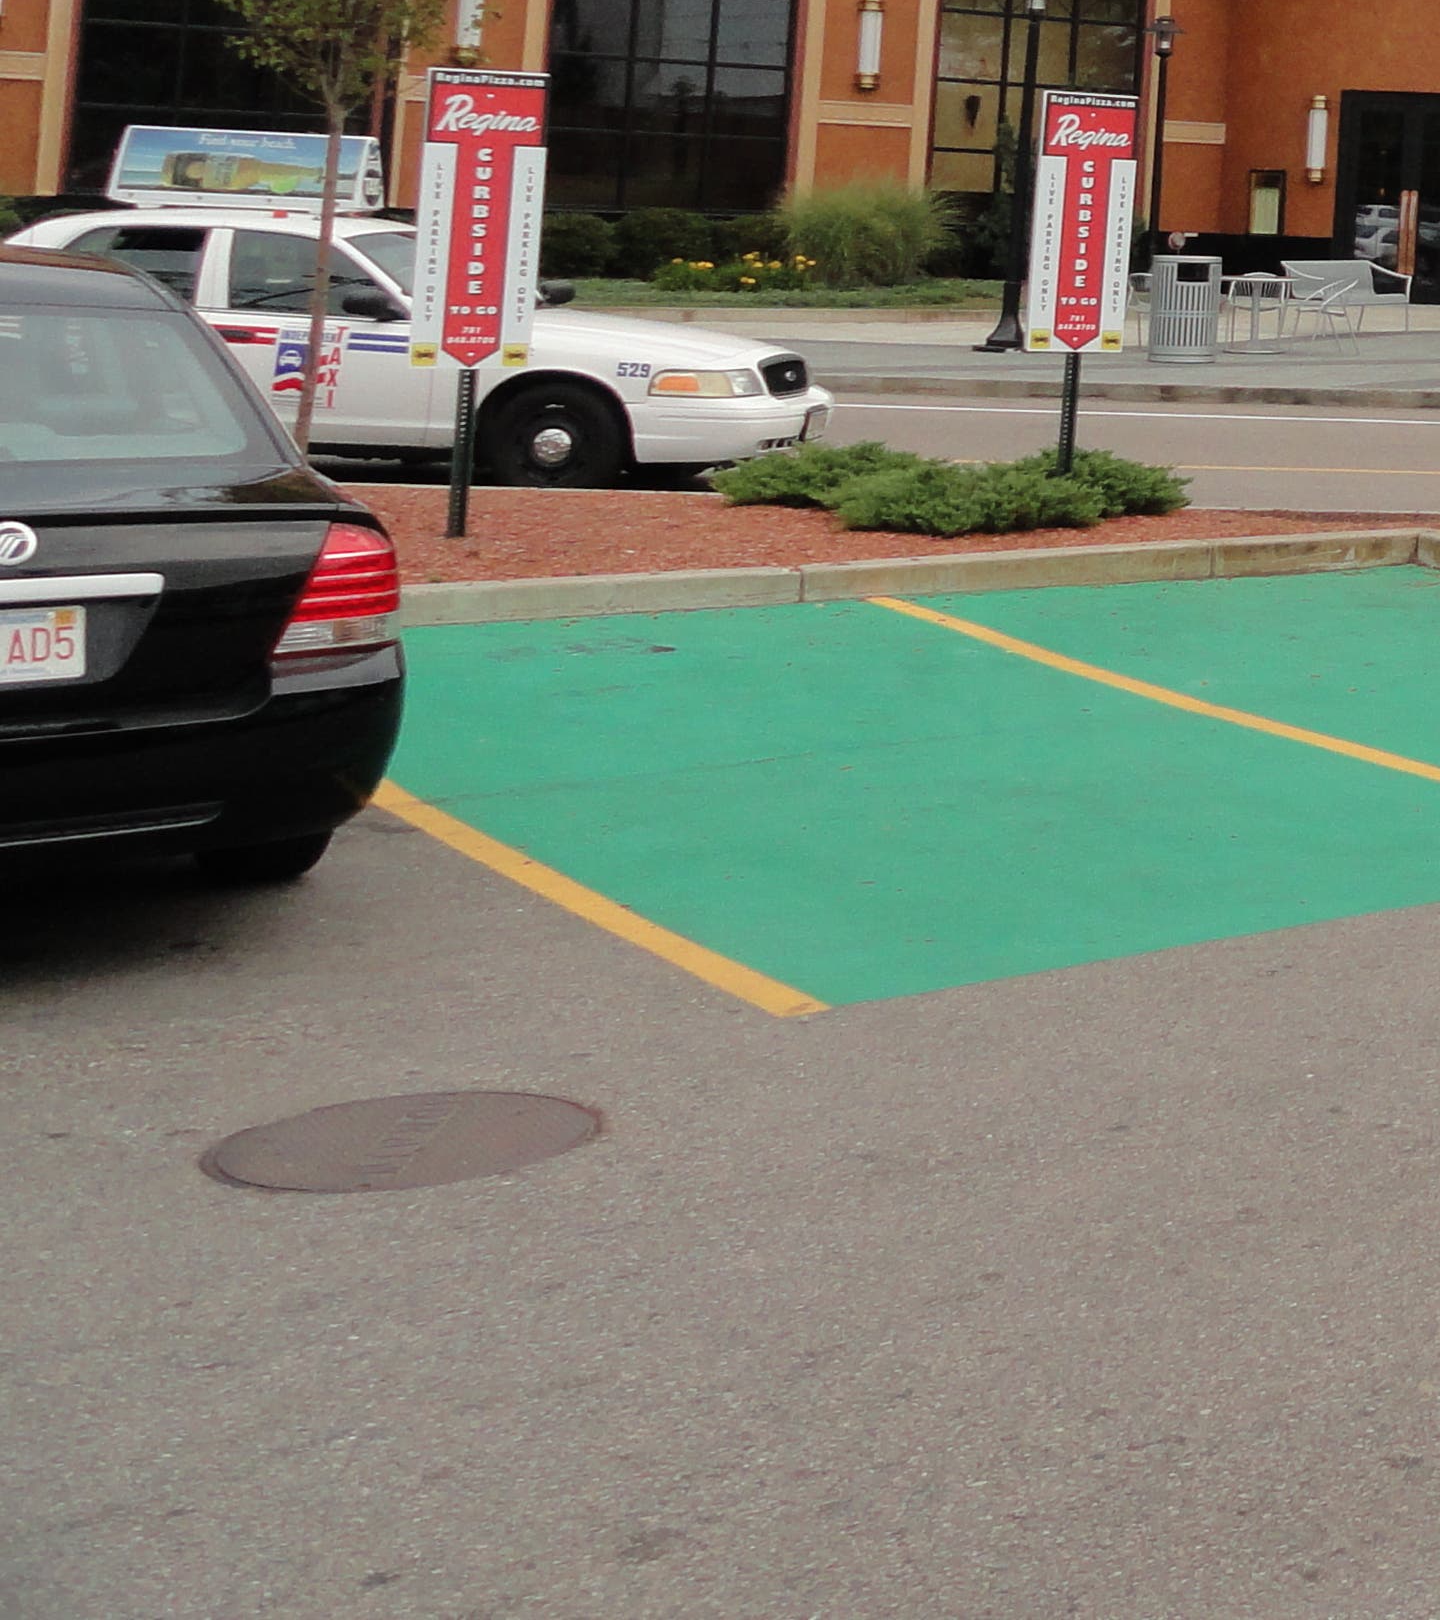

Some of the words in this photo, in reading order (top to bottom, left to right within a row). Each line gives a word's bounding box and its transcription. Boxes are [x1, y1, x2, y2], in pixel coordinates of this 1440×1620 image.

[435, 71, 546, 87] ReginaPizza.com
[434, 93, 542, 137] Regina
[1050, 94, 1136, 108] ReginaPizza.com
[1049, 113, 1132, 151] Regina
[467, 148, 495, 294] CURBSIDE
[1074, 160, 1095, 288] CURBSIDE
[449, 305, 472, 315] TO
[475, 306, 498, 315] GO
[1060, 296, 1077, 305] TO
[1080, 297, 1097, 306] GO
[325, 326, 350, 409] TAXI
[616, 362, 652, 378] 529
[6, 625, 75, 664] AD5
